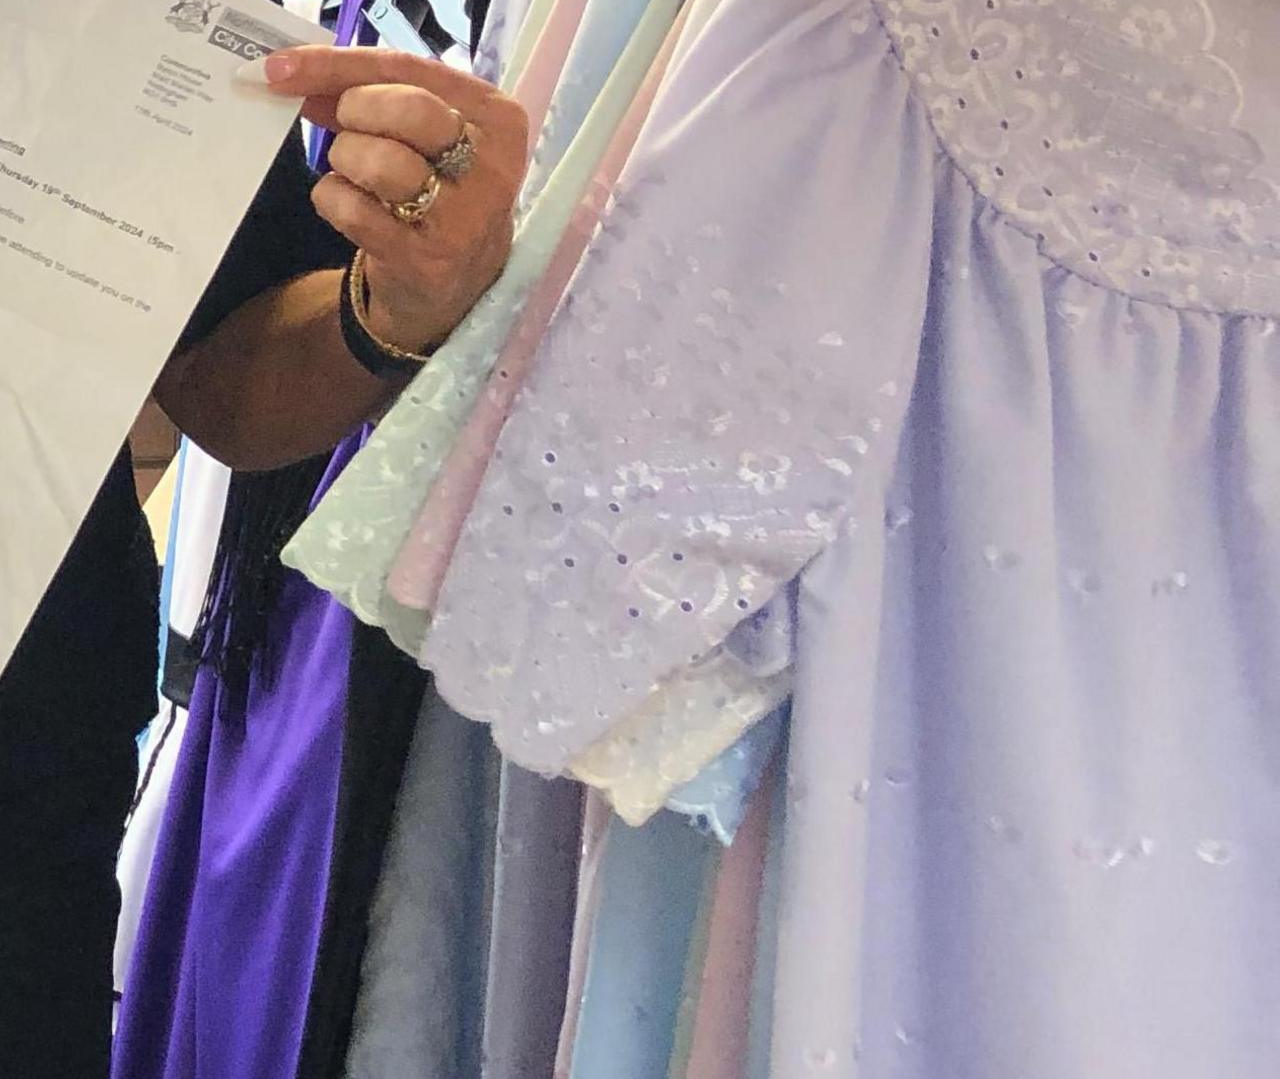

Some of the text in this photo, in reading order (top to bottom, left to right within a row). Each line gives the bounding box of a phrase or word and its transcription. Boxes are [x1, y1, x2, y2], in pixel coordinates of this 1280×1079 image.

[212, 28, 268, 62] City Co
[60, 192, 118, 226] September
[117, 219, 144, 238] 2024
[146, 233, 175, 254] (5pm
[53, 260, 66, 272] to
[99, 283, 119, 299] you
[133, 299, 152, 314] the
